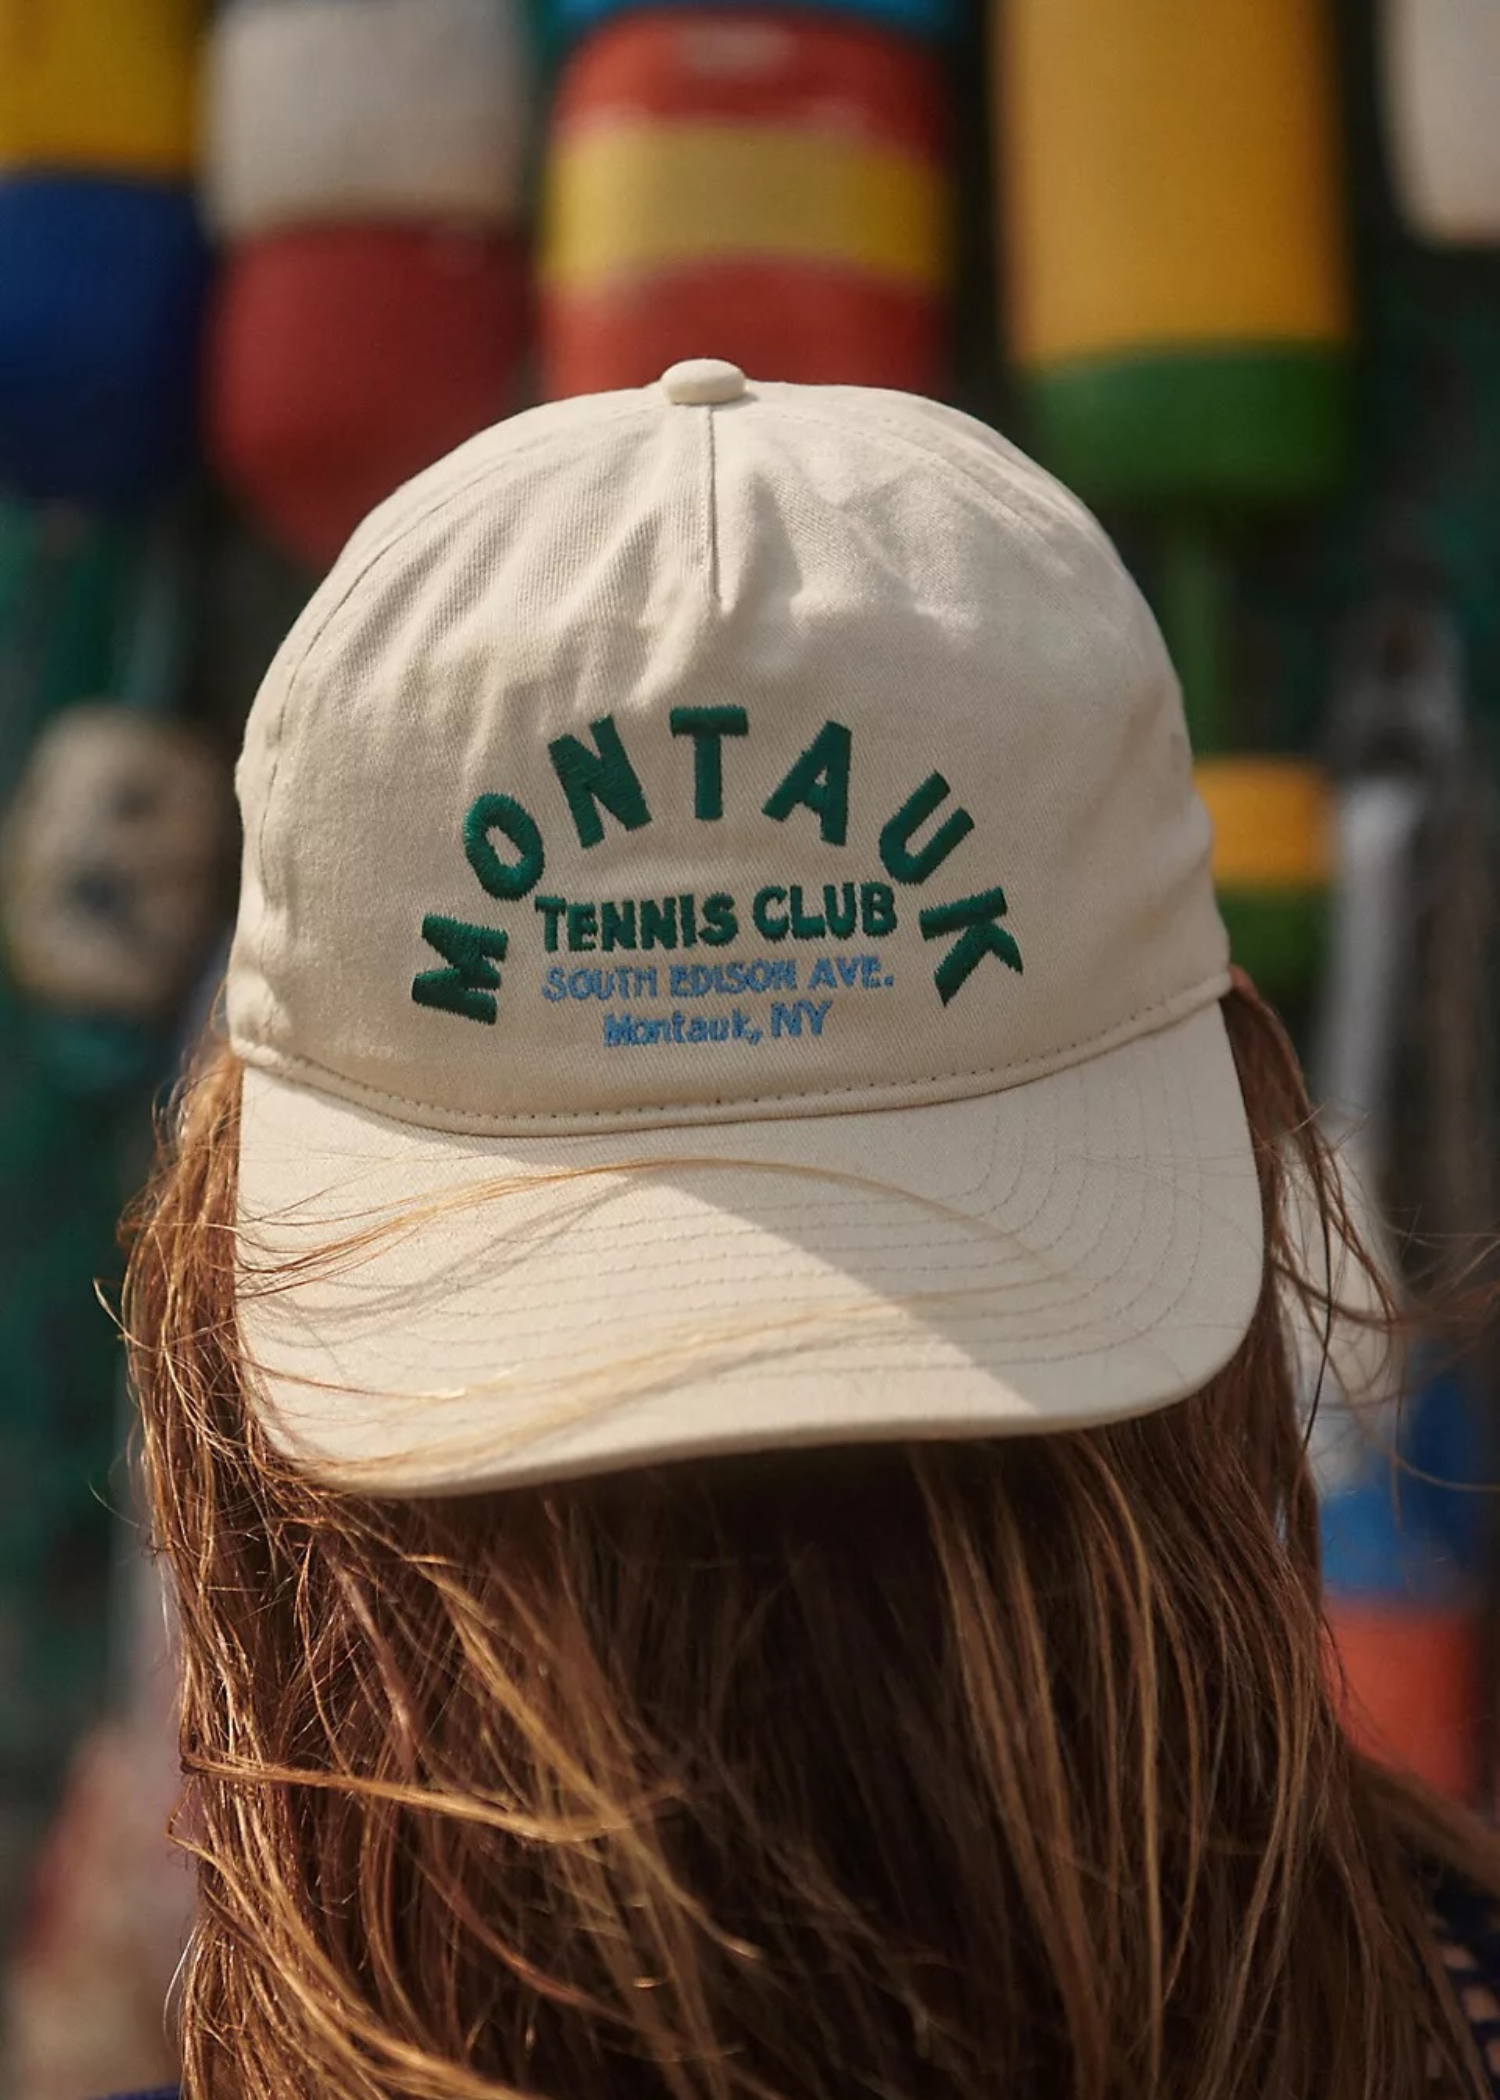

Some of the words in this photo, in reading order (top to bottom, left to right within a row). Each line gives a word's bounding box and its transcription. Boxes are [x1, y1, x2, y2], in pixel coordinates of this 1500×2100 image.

[411, 705, 1024, 1025] MONTAUK
[534, 893, 739, 952] TENNIS
[752, 881, 897, 941] CLUB
[541, 963, 659, 1002] SOUTH
[669, 957, 797, 996] EDISON
[807, 954, 894, 990] AVE.
[603, 1009, 763, 1047] Montauk,
[771, 1000, 832, 1037] NY
